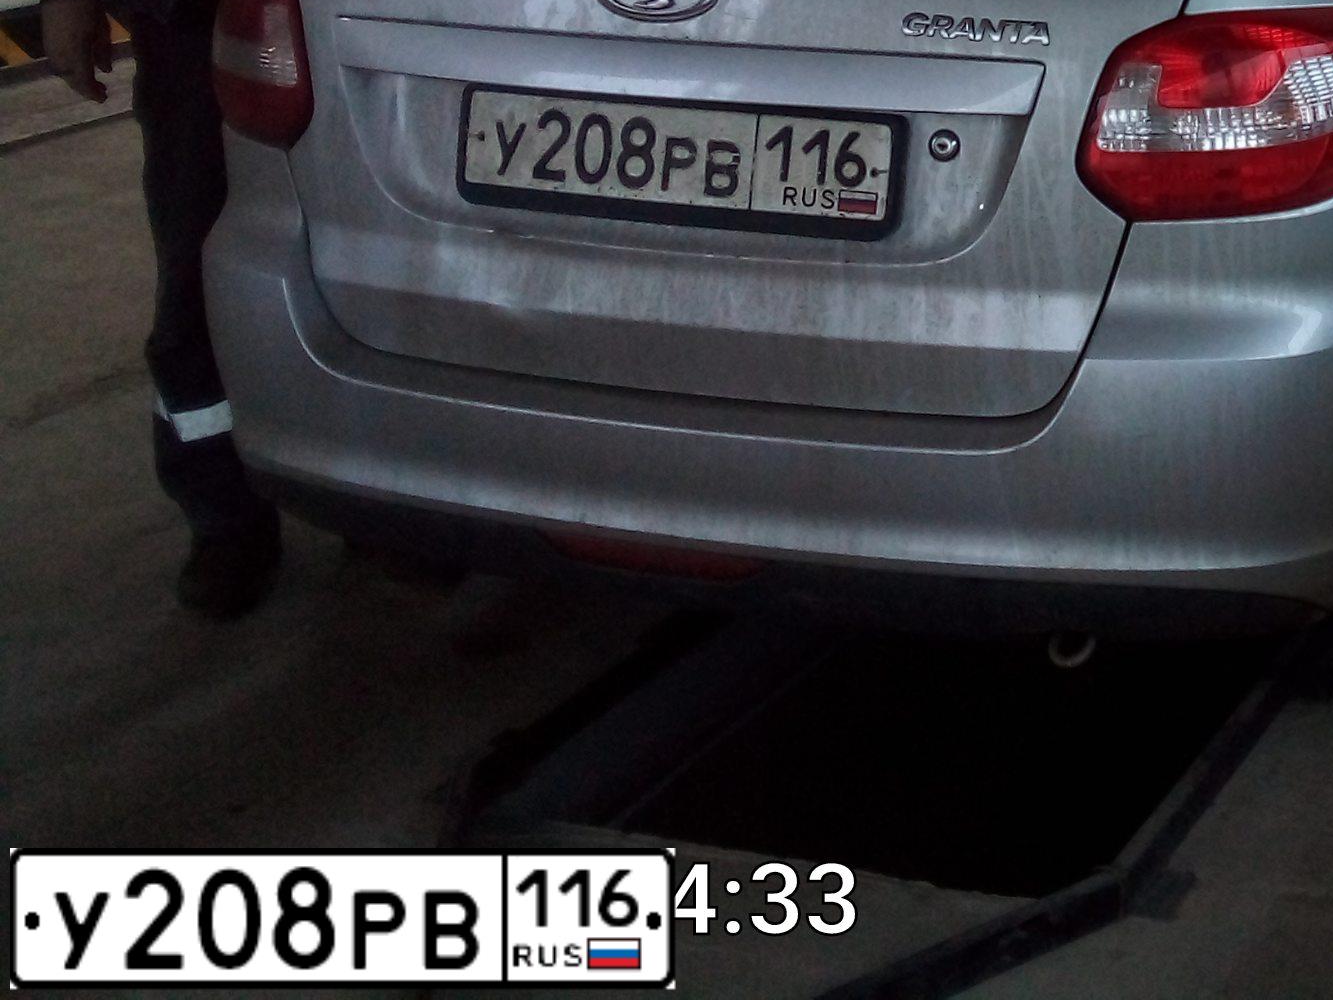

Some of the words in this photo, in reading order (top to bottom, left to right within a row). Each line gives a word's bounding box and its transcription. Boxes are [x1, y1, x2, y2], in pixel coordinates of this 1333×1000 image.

[901, 11, 1050, 47] GRANTA
[765, 124, 867, 188] 116
[782, 187, 835, 209] RUS
